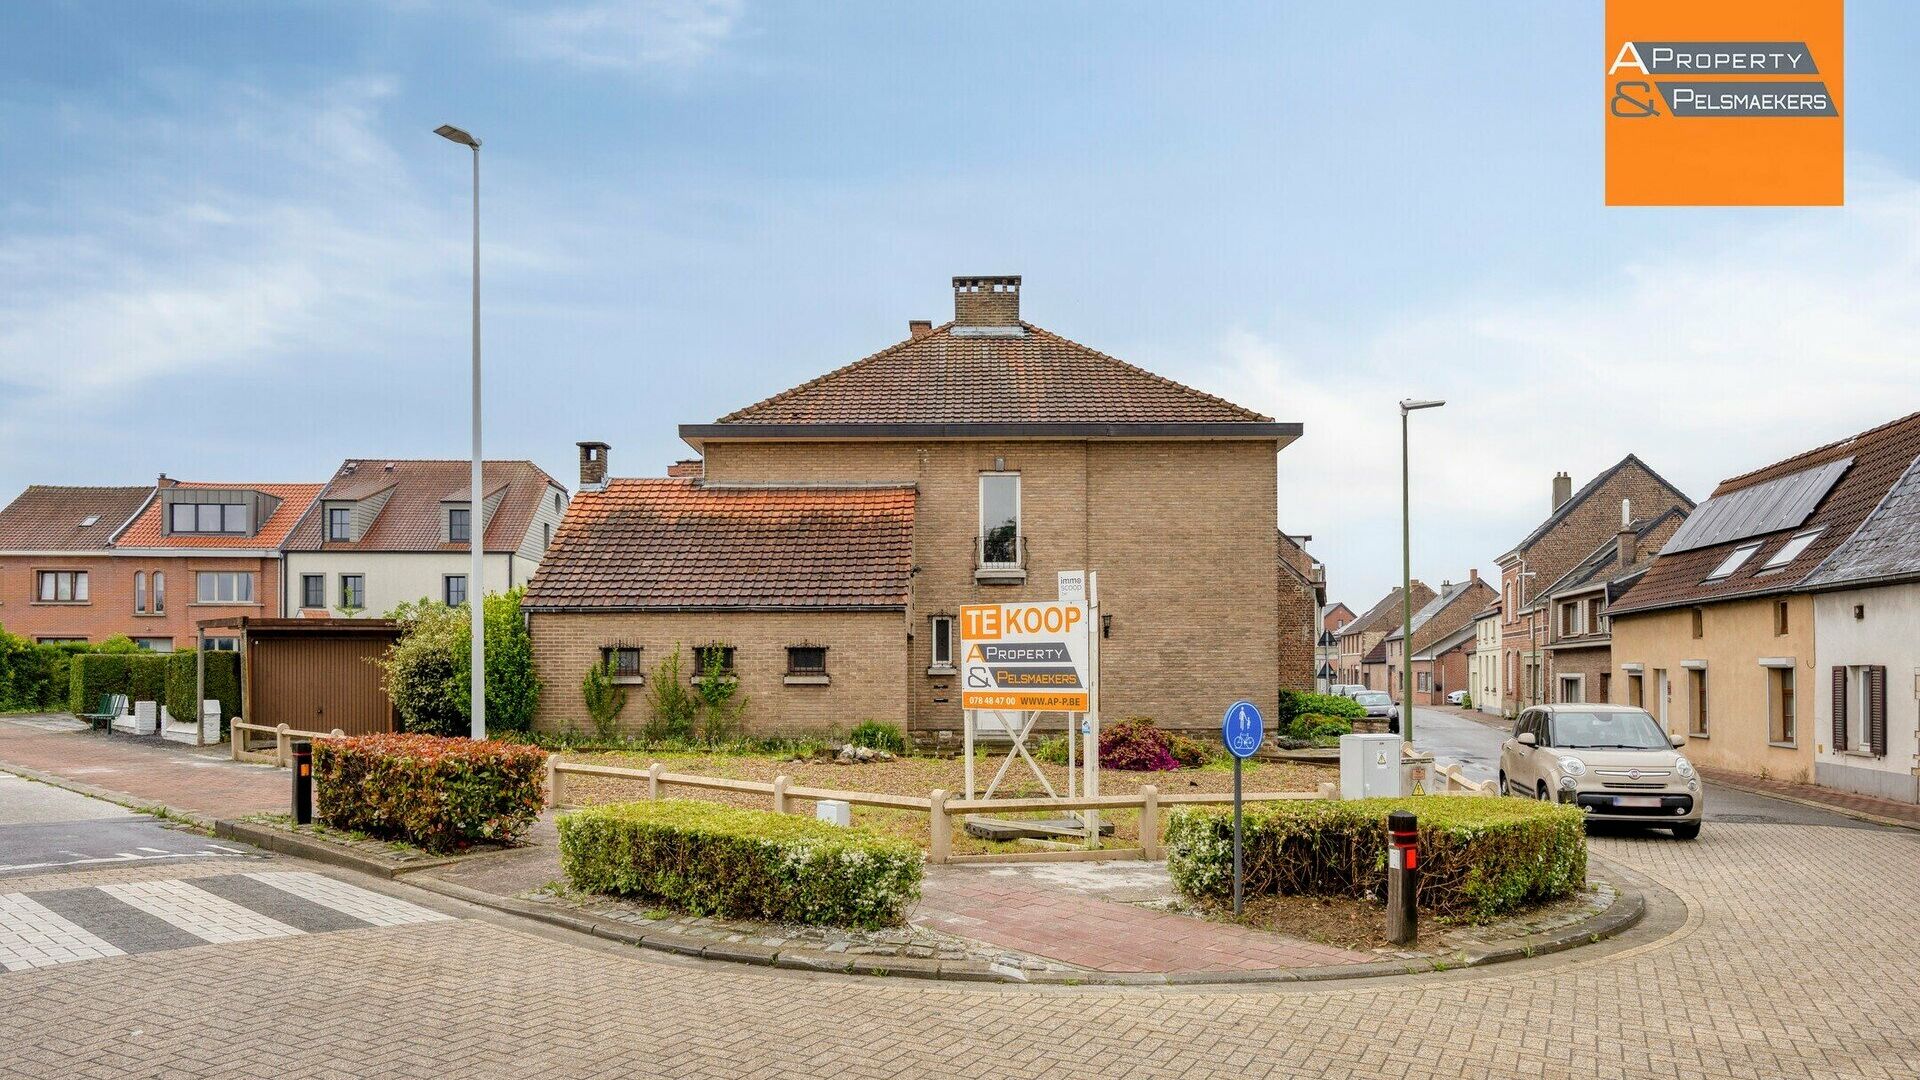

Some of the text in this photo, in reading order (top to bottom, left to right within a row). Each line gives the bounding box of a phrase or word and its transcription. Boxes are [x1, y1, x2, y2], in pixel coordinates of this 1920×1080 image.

[966, 607, 1081, 635] TE KOOP
[966, 644, 1063, 663] A PROPERTY
[968, 666, 1077, 688] & PELSMAEKERS
[969, 696, 1080, 706] 078 48 47 00 WWW.AP-P.BE
